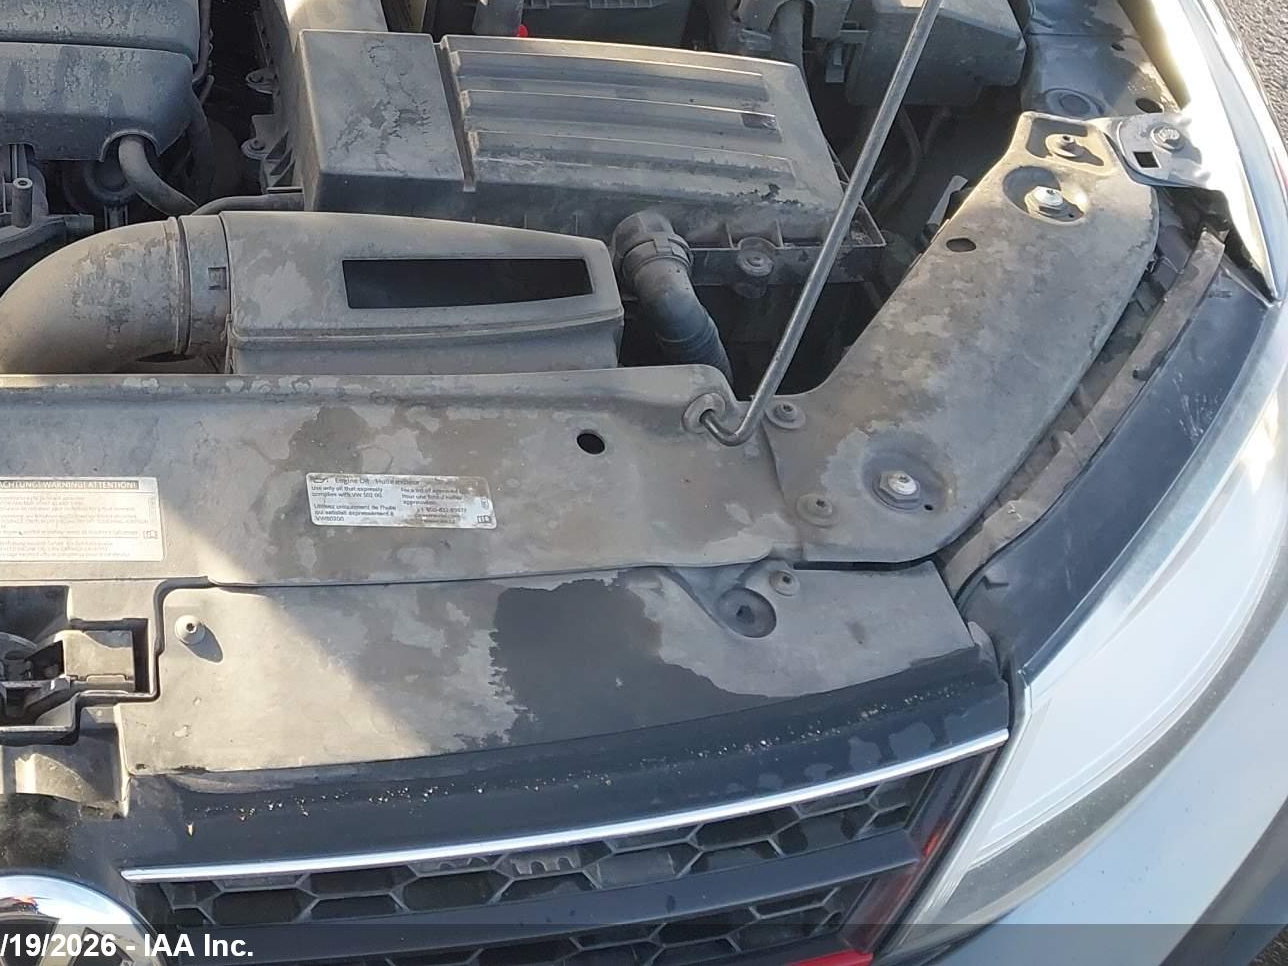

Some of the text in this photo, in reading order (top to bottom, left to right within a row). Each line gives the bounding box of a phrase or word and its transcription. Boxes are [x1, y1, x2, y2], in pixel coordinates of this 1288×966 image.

[43, 481, 87, 489] WARNING!
[88, 481, 137, 489] ATTENTION!
[335, 477, 359, 485] Engine
